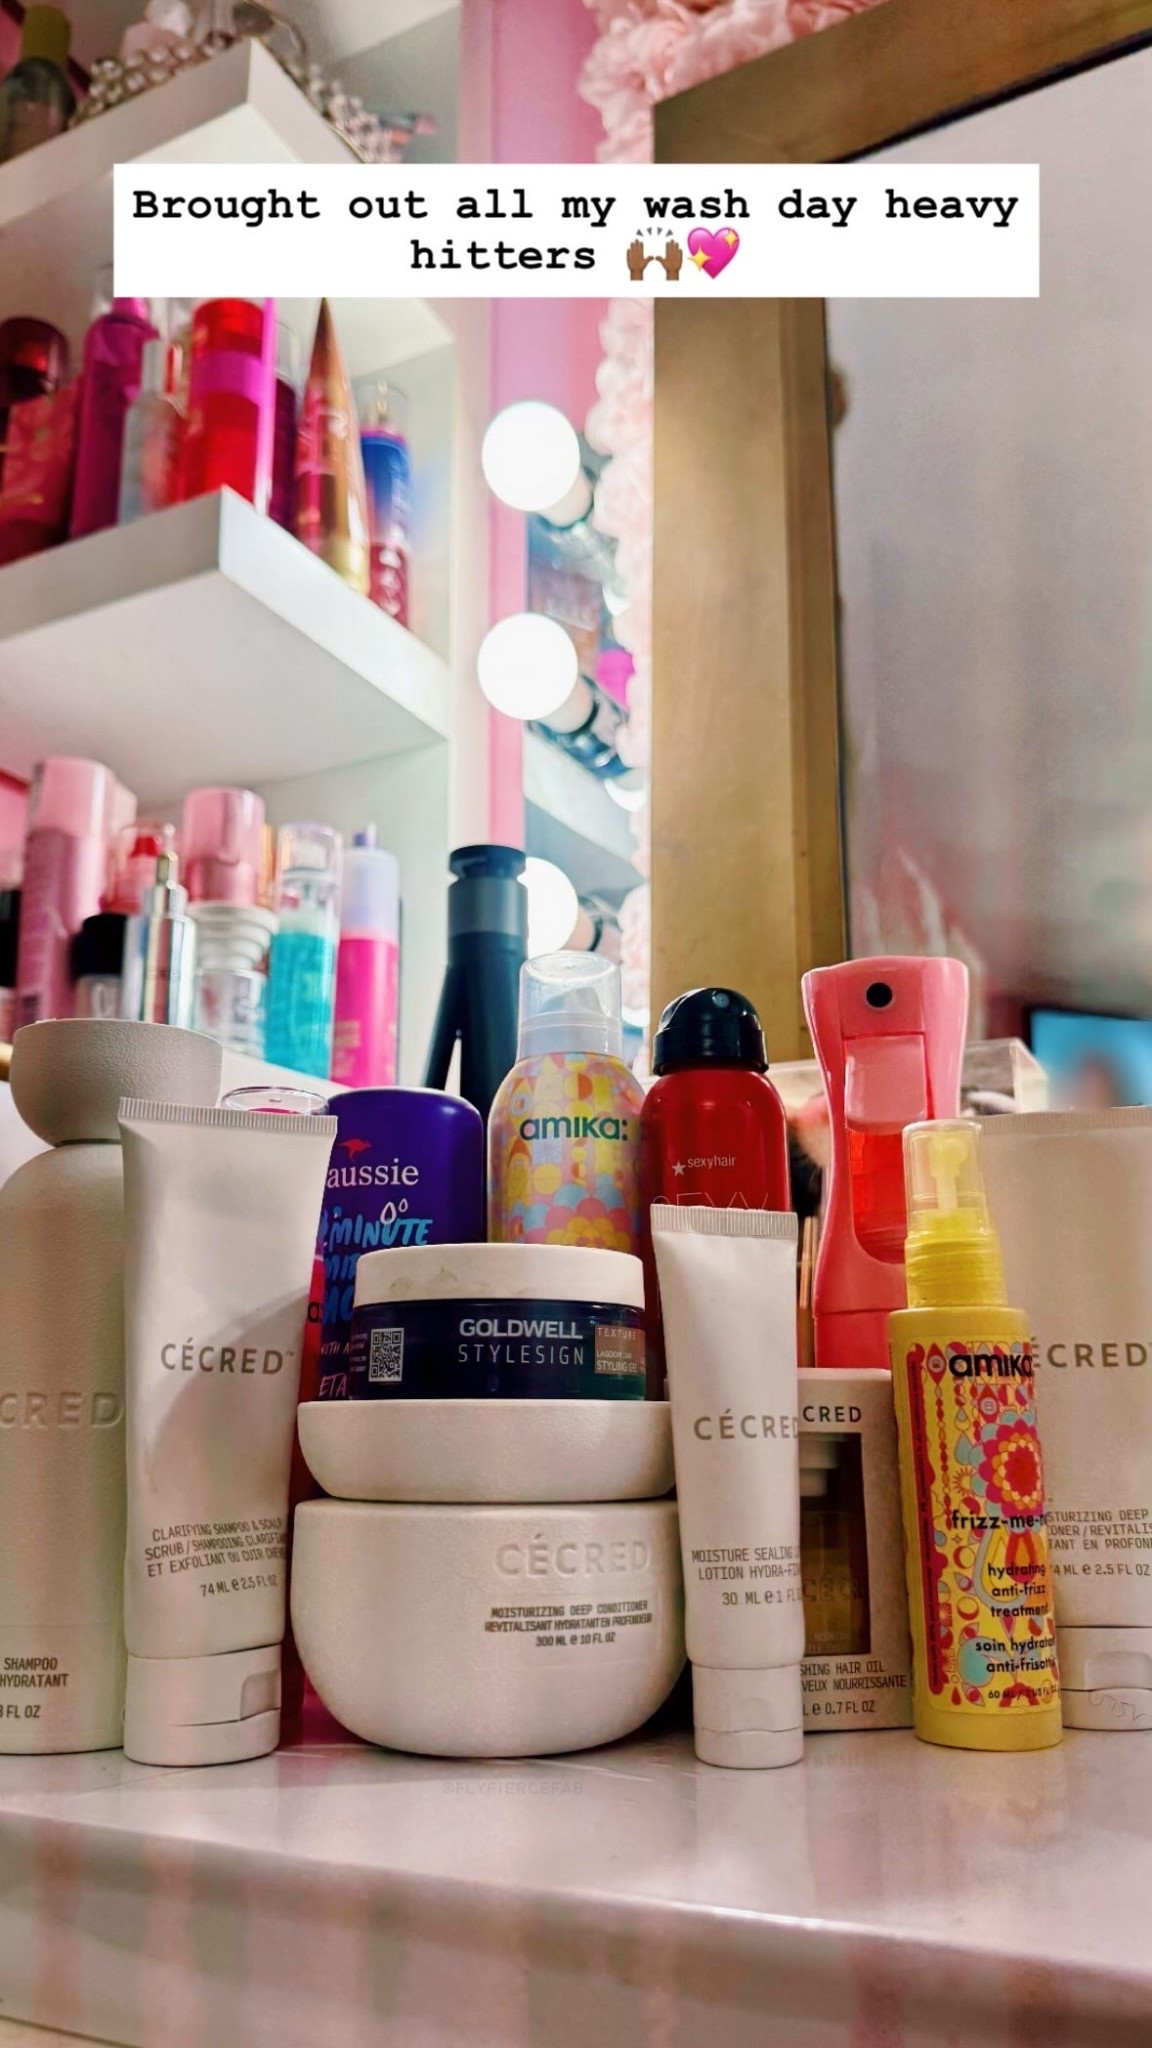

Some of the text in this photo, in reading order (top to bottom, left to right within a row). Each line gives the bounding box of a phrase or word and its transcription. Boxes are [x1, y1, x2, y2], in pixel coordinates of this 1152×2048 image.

[520, 1117, 627, 1141] amika:
[687, 1154, 736, 1170] sexyhair
[327, 1157, 419, 1189] aussie
[459, 1318, 583, 1340] GOLDWELL
[597, 1327, 637, 1341] TEXTURE
[321, 1341, 341, 1355] ITH
[458, 1344, 584, 1366] STYLESIGN
[596, 1360, 628, 1372] STYLING
[0, 1391, 124, 1428] CRED
[802, 1405, 862, 1423] CRED
[1119, 1508, 1149, 1521] DEEP
[152, 1523, 212, 1542] CLARIFYING
[213, 1520, 251, 1535] SHAMPOO
[1048, 1538, 1074, 1550] TANT
[1083, 1537, 1098, 1550] EN
[495, 1533, 650, 1577] CÉCRED
[692, 1548, 749, 1562] MOISTURE
[754, 1545, 793, 1561] SEALING
[147, 1564, 163, 1577] ET
[170, 1552, 228, 1573] EXFOLIANT
[241, 1548, 264, 1561] CUIR
[988, 1562, 1046, 1579] hydrating
[1063, 1564, 1079, 1576] ML
[1095, 1563, 1114, 1575] 2.5
[1117, 1563, 1133, 1575] FL
[1135, 1563, 1151, 1576] OZ
[698, 1566, 744, 1580] LOTION
[201, 1584, 215, 1597] 74
[216, 1581, 230, 1593] ML
[241, 1574, 257, 1590] 2.5
[257, 1574, 269, 1588] FL
[991, 1582, 1046, 1597] anti-frizz
[721, 1591, 738, 1605] 30
[744, 1590, 761, 1605] ML
[776, 1589, 783, 1603] 1
[491, 1599, 648, 1619] MOISTURIZING DEEP CONDITIONER
[991, 1603, 1049, 1617] treatment
[484, 1612, 653, 1632] REVITALISANT HYDRATANT EN PROFONDEUR
[535, 1635, 554, 1647] 300
[580, 1633, 591, 1645] 10
[592, 1633, 603, 1645] FL
[604, 1631, 617, 1643] OZ
[975, 1638, 1006, 1651] soin
[4, 1657, 58, 1671] SHAMPOO
[836, 1661, 861, 1674] HAIR
[866, 1660, 886, 1673] OIL
[0, 1673, 69, 1688] HYDRATANT
[802, 1675, 908, 1693] VEUX NOURRISSANTE
[988, 1690, 1000, 1699] 60
[6, 1704, 20, 1718] FL
[25, 1705, 41, 1718] OZ
[825, 1702, 843, 1715] 0.7
[845, 1701, 859, 1714] FL
[862, 1700, 877, 1713] OZ
